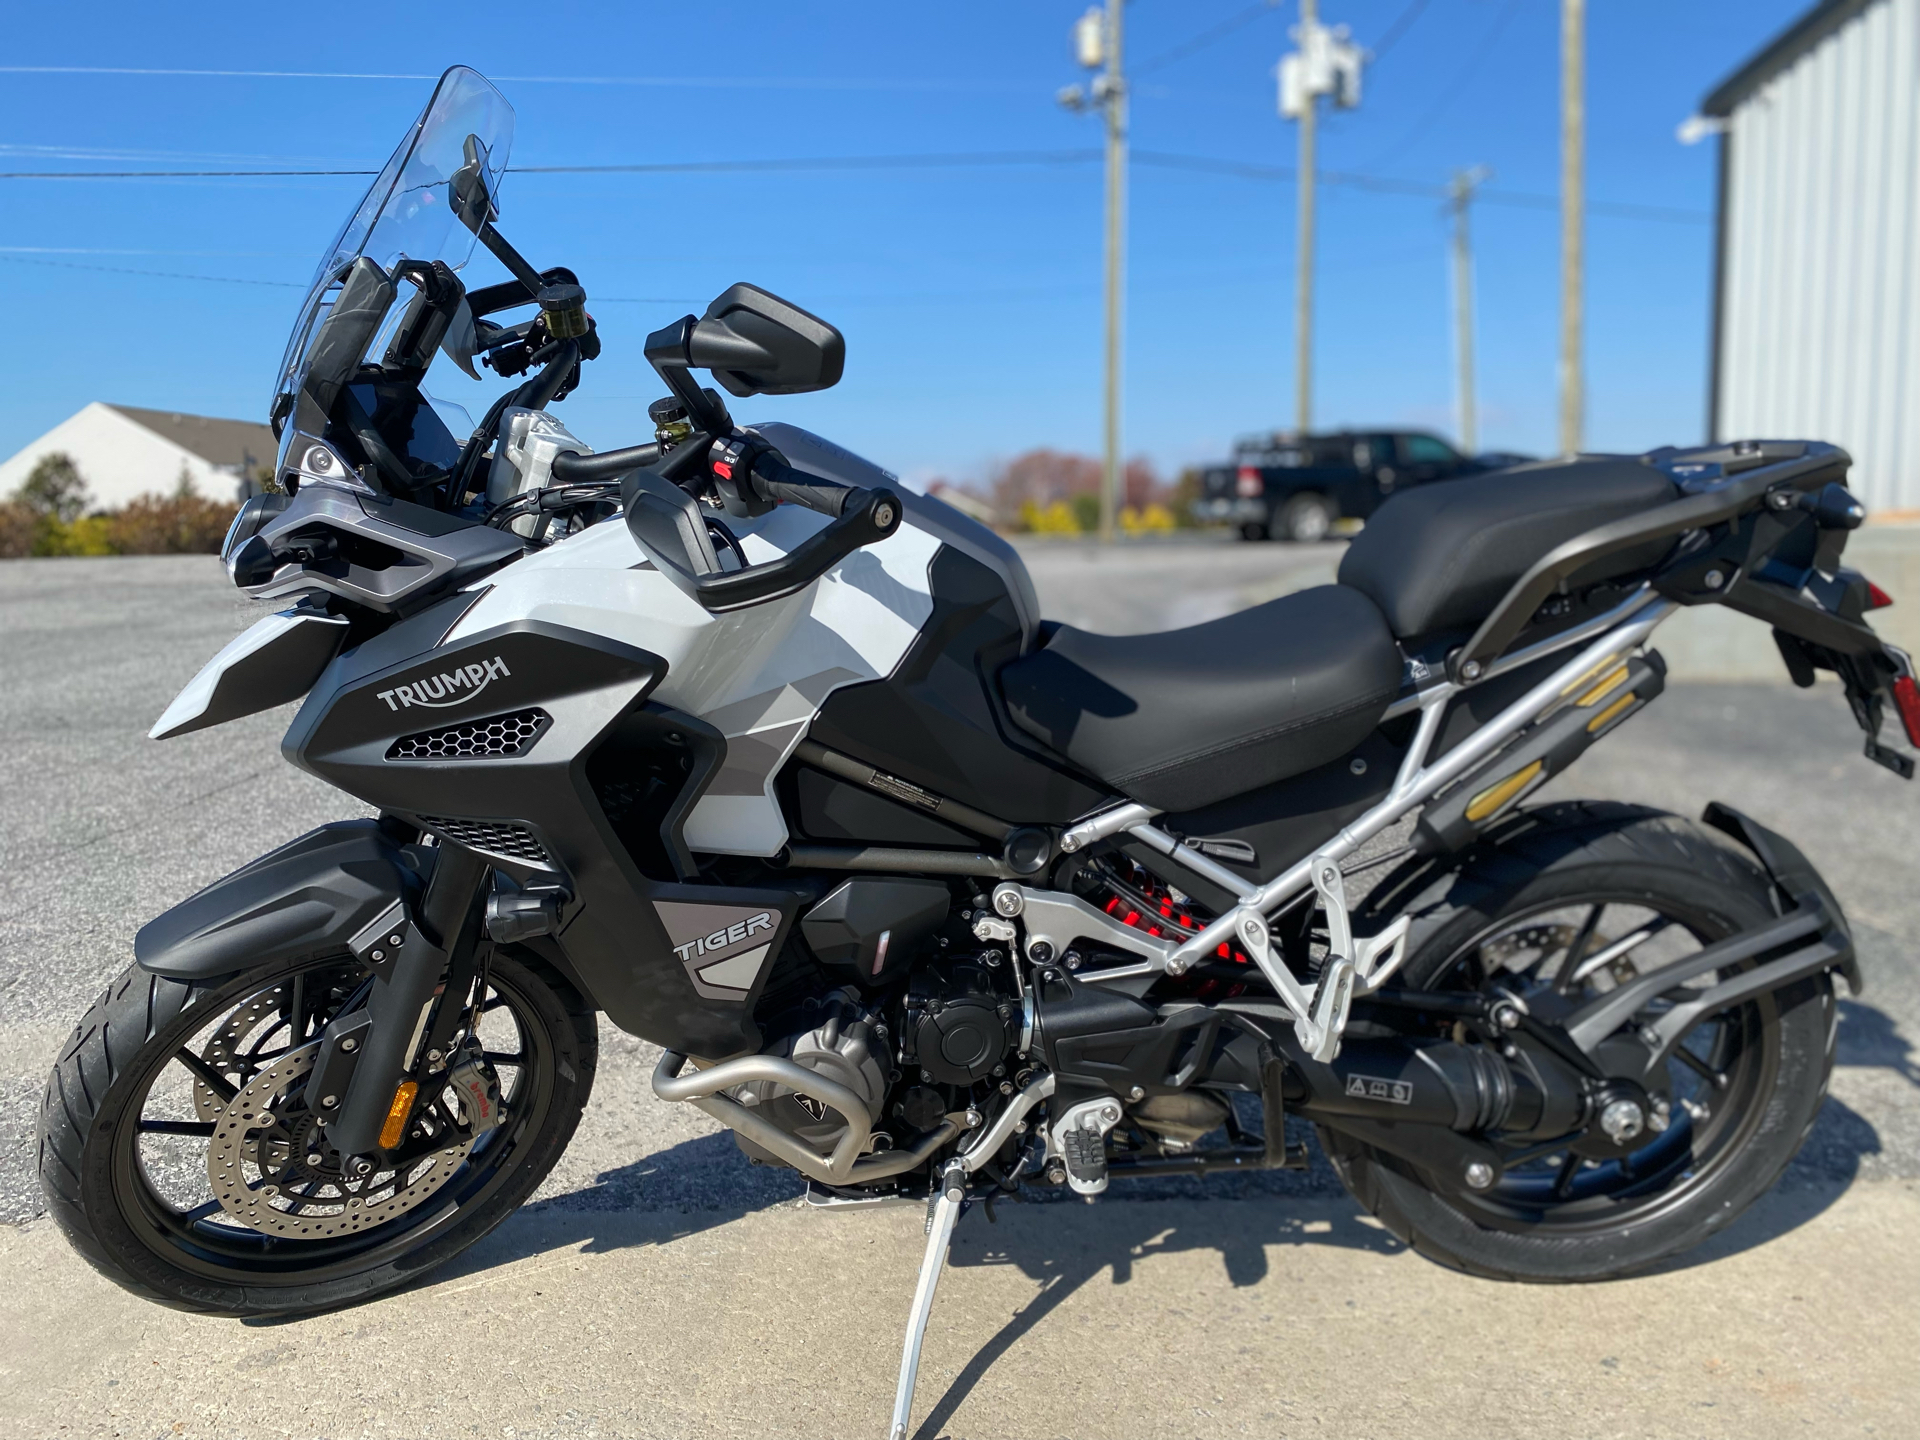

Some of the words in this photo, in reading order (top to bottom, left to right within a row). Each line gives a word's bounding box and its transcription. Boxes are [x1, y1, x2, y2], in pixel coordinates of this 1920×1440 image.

[376, 656, 512, 711] TRIUMPH
[673, 912, 774, 962] TIGER
[470, 1081, 491, 1118] brembo
